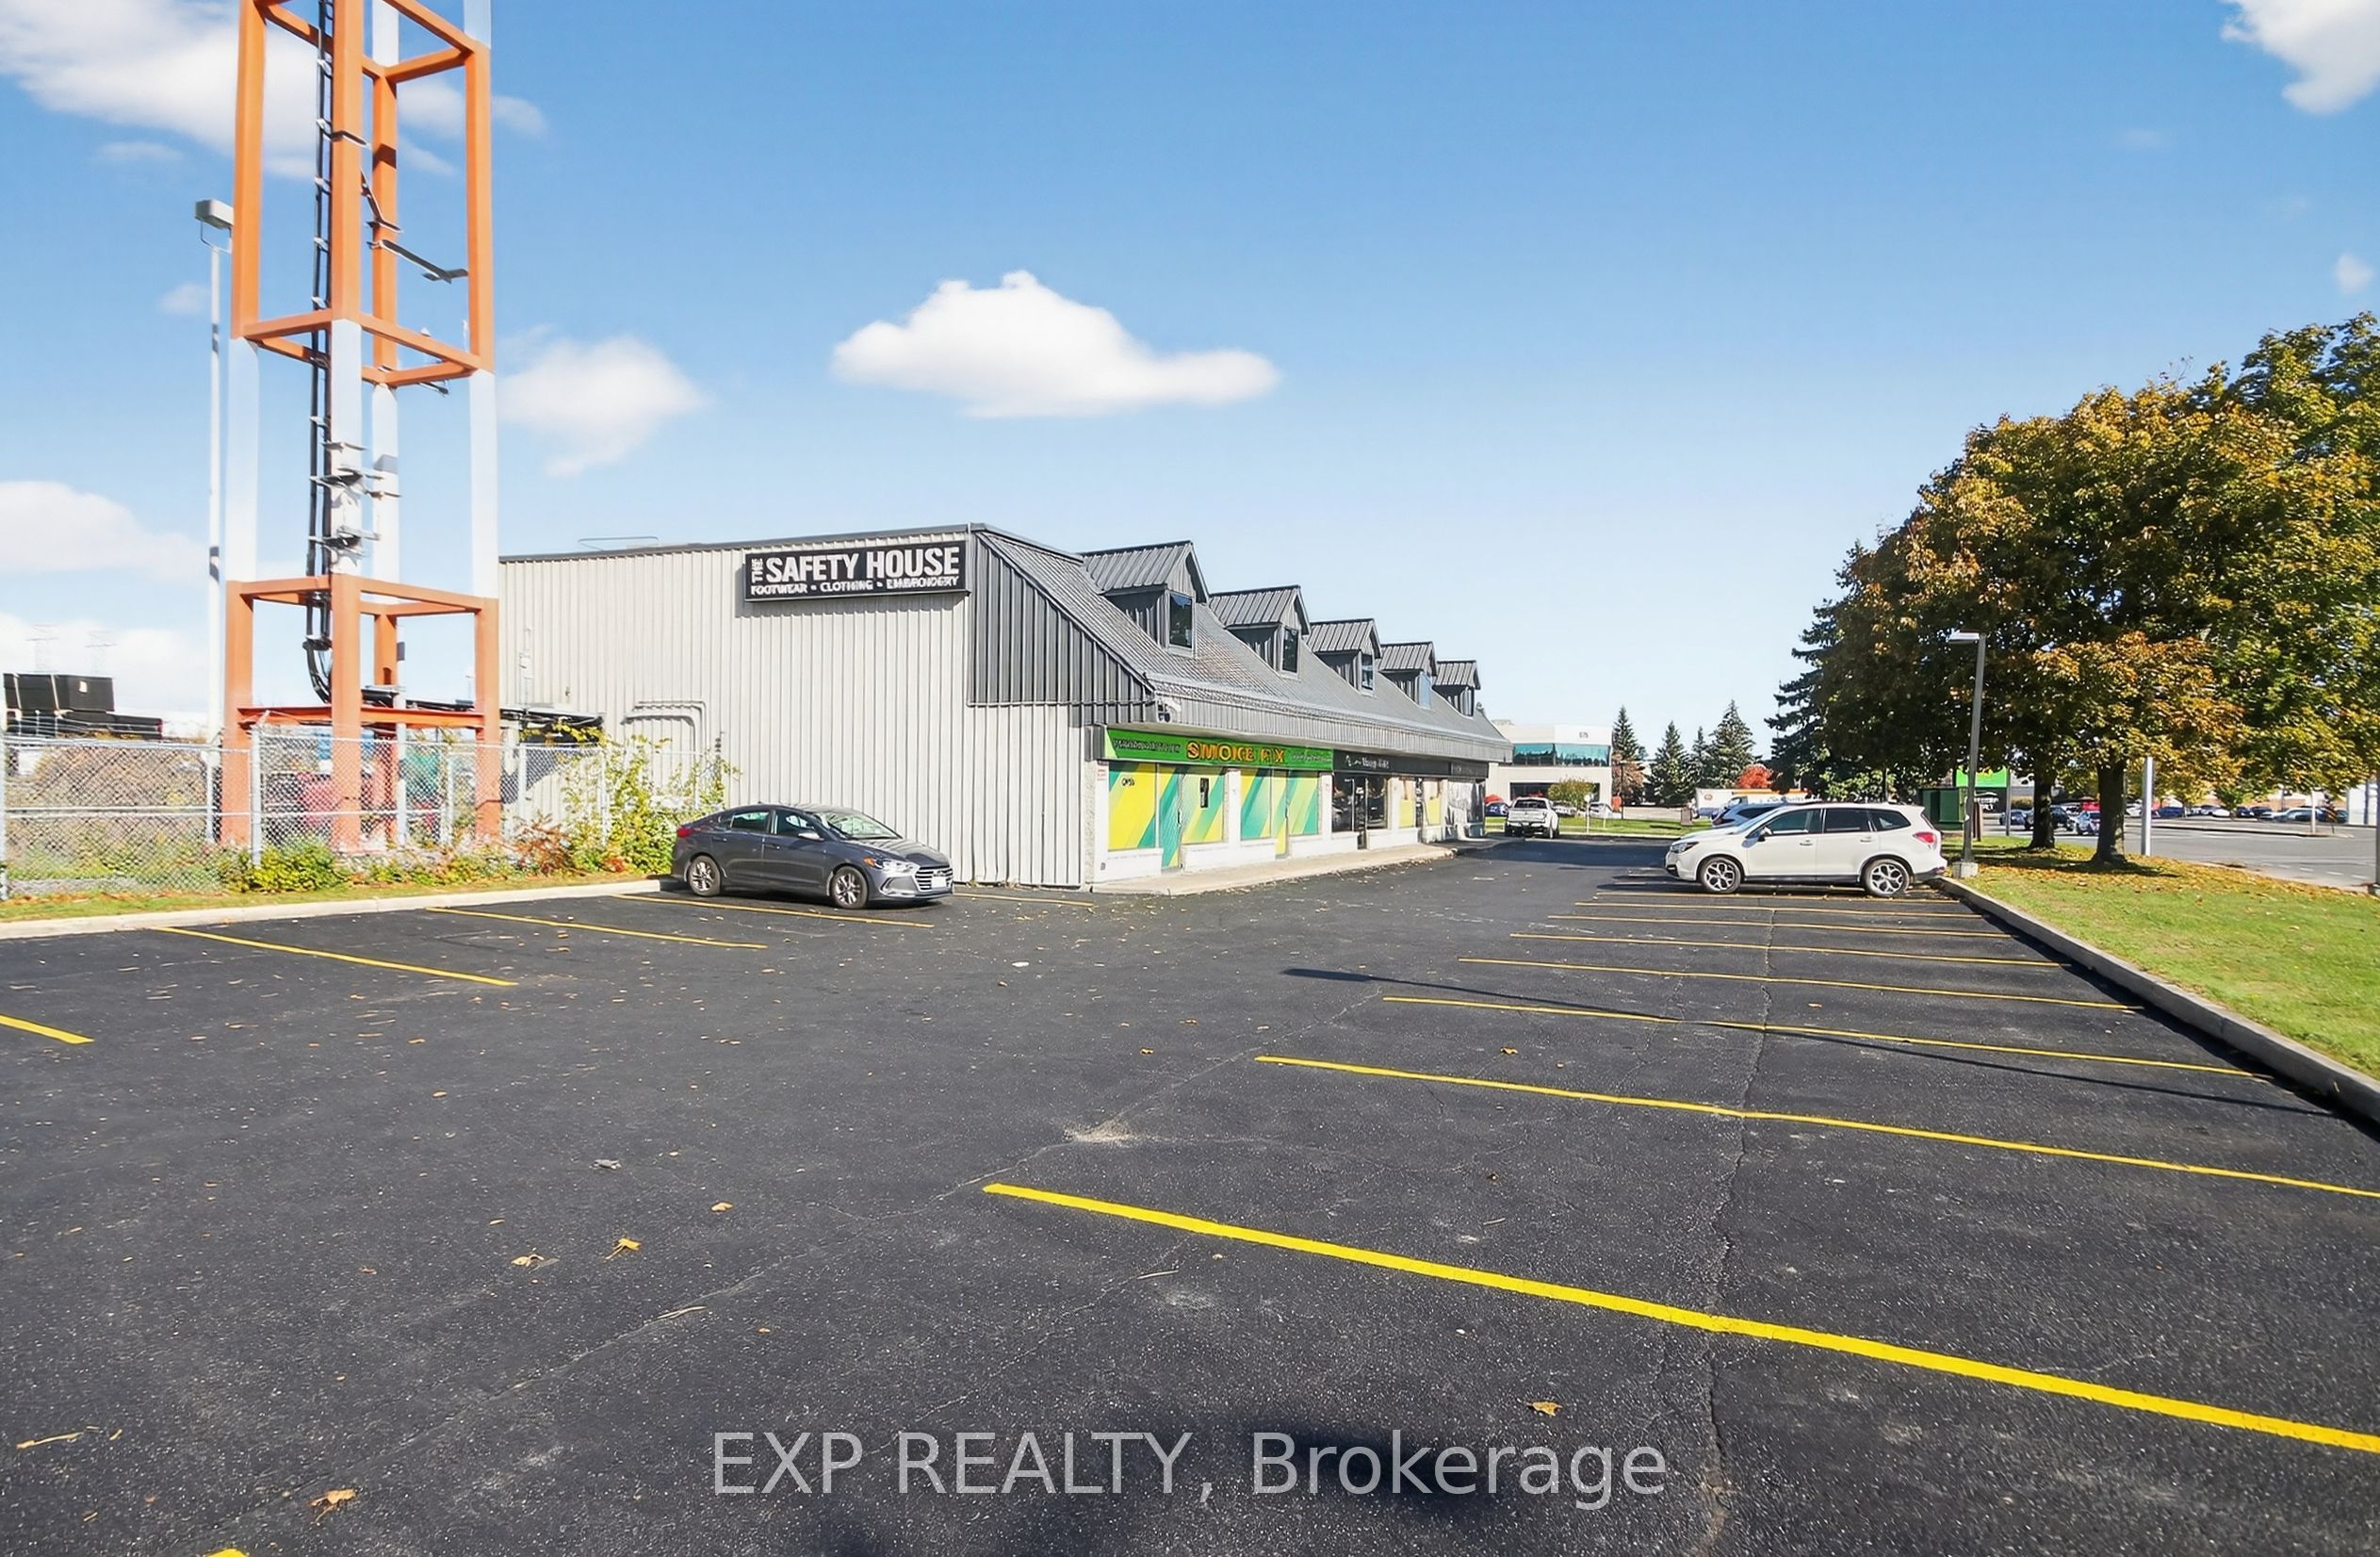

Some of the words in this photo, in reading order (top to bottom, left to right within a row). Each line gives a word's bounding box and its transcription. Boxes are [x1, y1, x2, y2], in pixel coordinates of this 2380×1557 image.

[766, 553, 859, 582] SAFETY
[866, 547, 960, 579] HOUSE
[751, 583, 808, 596] FOOTWEAR
[820, 580, 873, 592] CLOTHING
[1186, 741, 1255, 762] SMOKE
